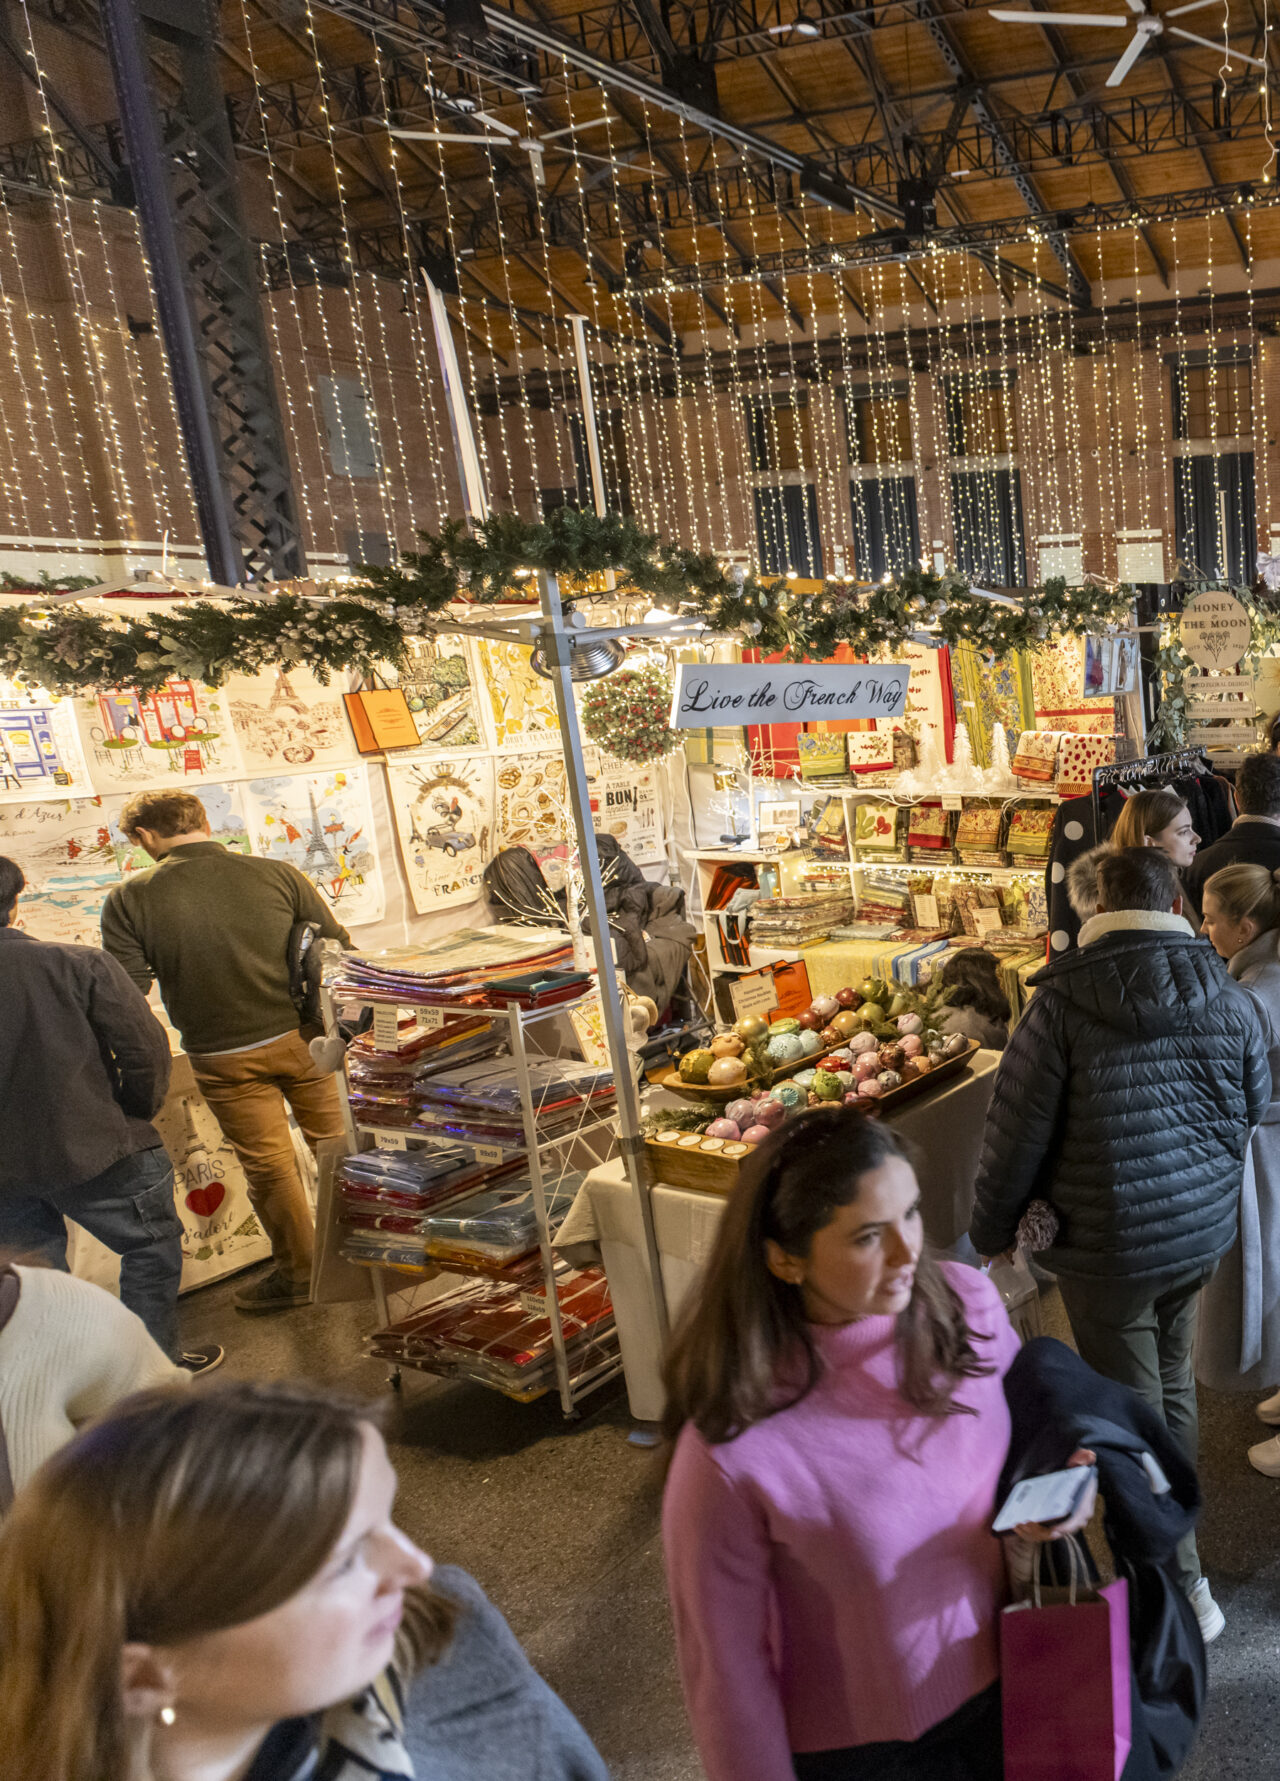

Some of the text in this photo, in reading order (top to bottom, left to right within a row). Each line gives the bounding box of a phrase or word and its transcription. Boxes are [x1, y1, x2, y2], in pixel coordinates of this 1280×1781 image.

[1193, 602, 1235, 613] HONEY
[1183, 618, 1247, 630] THE MOON
[681, 678, 903, 712] Live the French Way
[606, 789, 632, 806] BON
[174, 1159, 226, 1195] PARIS
